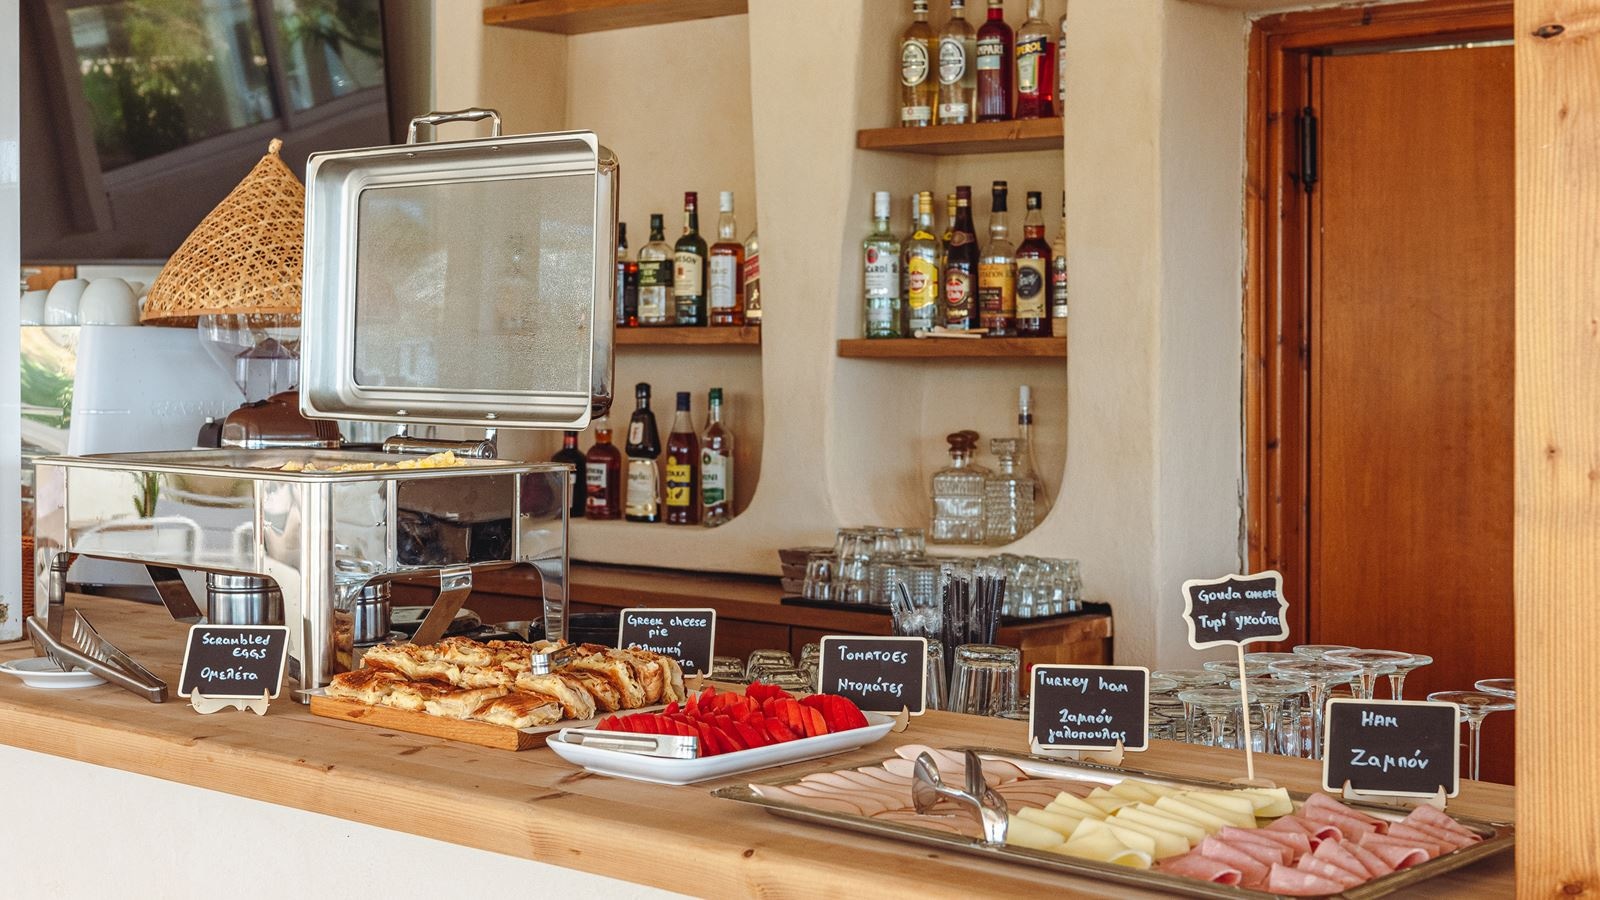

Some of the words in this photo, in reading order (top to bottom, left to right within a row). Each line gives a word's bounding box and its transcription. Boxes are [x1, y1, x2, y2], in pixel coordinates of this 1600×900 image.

[1198, 586, 1241, 604] Gouda
[627, 614, 663, 627] Greek
[670, 616, 707, 627] cheese
[1198, 612, 1226, 632] Τυρί
[648, 626, 668, 638] pie
[200, 666, 258, 682] Ομελέτα
[1037, 670, 1089, 694] Turkey
[1098, 676, 1129, 693] ham
[837, 676, 904, 697] Ντομάτες
[1361, 710, 1398, 728] HAM
[1350, 749, 1429, 773] Ζαμπόν
